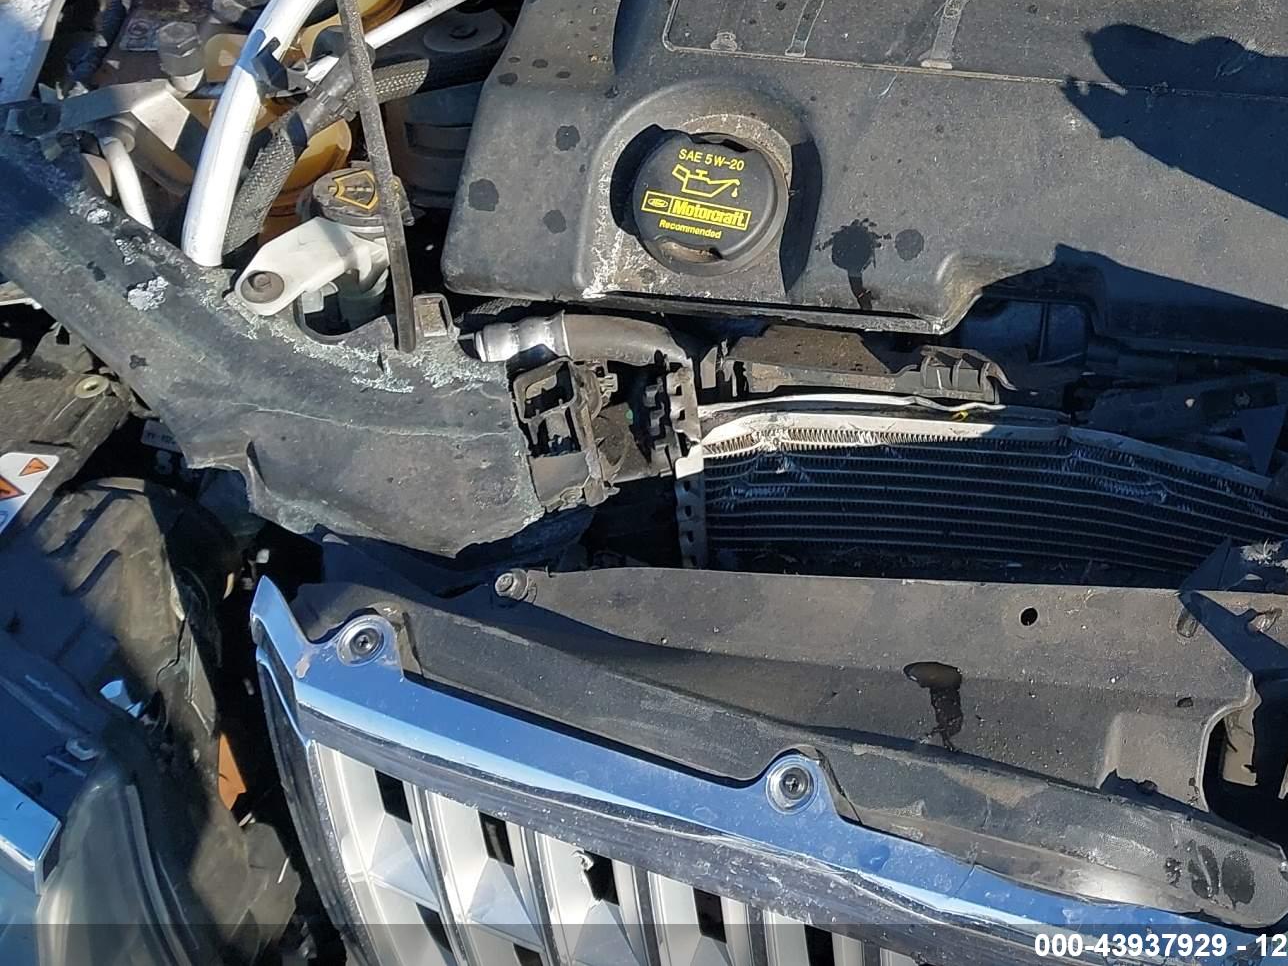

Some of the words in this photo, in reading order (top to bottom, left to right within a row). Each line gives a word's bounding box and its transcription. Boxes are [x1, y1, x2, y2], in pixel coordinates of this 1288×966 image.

[678, 148, 703, 164] SAE
[704, 153, 745, 171] 5W-20
[672, 200, 745, 227] Motorcraft
[659, 219, 722, 239] Recommended
